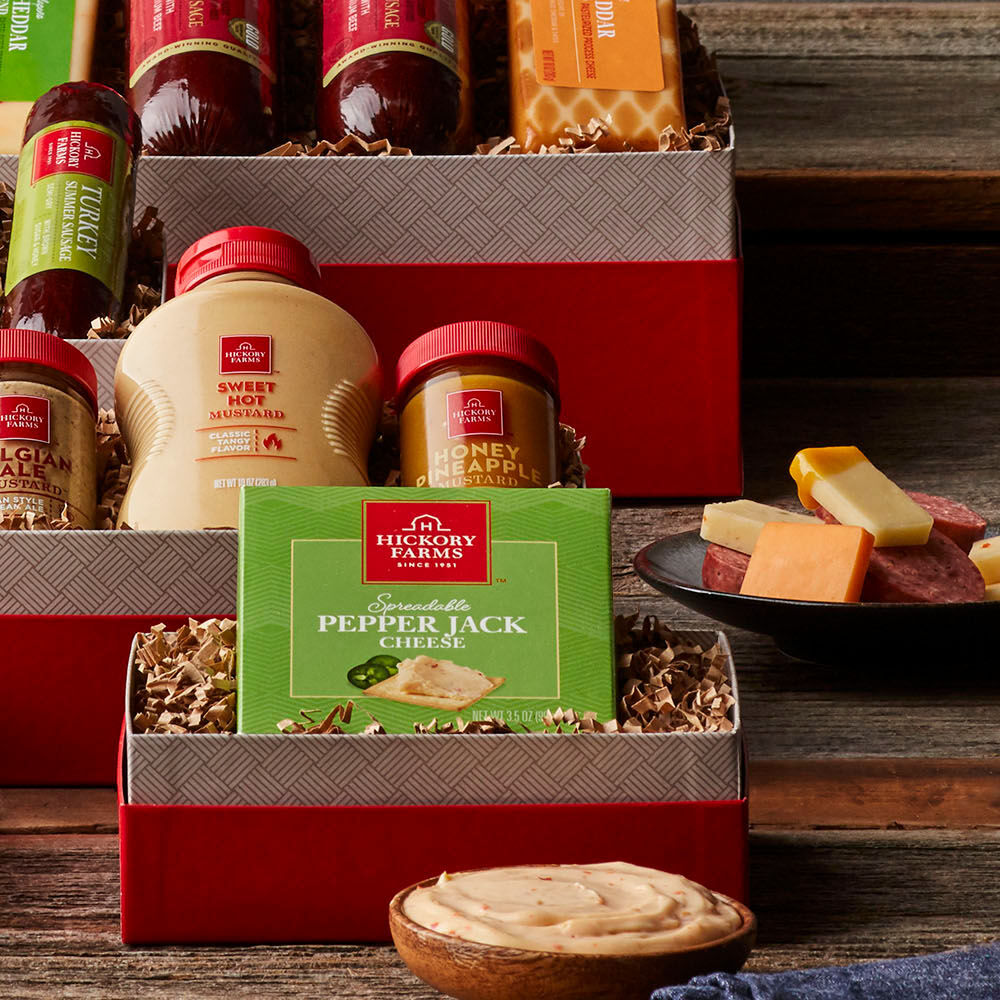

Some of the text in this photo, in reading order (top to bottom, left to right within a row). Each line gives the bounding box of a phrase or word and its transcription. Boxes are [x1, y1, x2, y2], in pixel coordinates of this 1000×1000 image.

[152, 13, 162, 32] BEEF
[348, 15, 358, 33] BEEF
[580, 3, 592, 36] PASTEURIZED
[245, 23, 260, 50] GOLD
[582, 37, 594, 61] PROCESS
[585, 61, 596, 79] CHEESE
[55, 137, 68, 165] FARMS
[68, 131, 82, 168] HICKORY
[59, 180, 78, 262] SUMMER SAUSAGE
[76, 185, 103, 259] TURKEY
[217, 381, 276, 393] SWEET
[228, 395, 266, 406] HOT
[0, 414, 44, 424] HICKORY
[209, 409, 284, 420] MUSTARD
[452, 409, 496, 419] HICKORY
[459, 416, 492, 424] FARMS
[6, 421, 39, 429] FARMS
[209, 431, 250, 439] CLASSIC
[210, 444, 250, 452] FLAVOR
[433, 442, 520, 466] HONEY
[0, 463, 46, 481] ALE
[416, 458, 542, 487] PINEAPPLE
[438, 474, 518, 488] MUSTARD
[13, 497, 44, 505] STYLE
[376, 534, 476, 547] HICKORY
[390, 547, 463, 559] FARMS
[367, 592, 471, 615] Spreadable
[317, 615, 527, 638] PEPPER JACK
[379, 636, 466, 649] CHEESE
[472, 711, 487, 721] NET
[507, 711, 519, 721] 3.5
[522, 711, 534, 721] OZ
